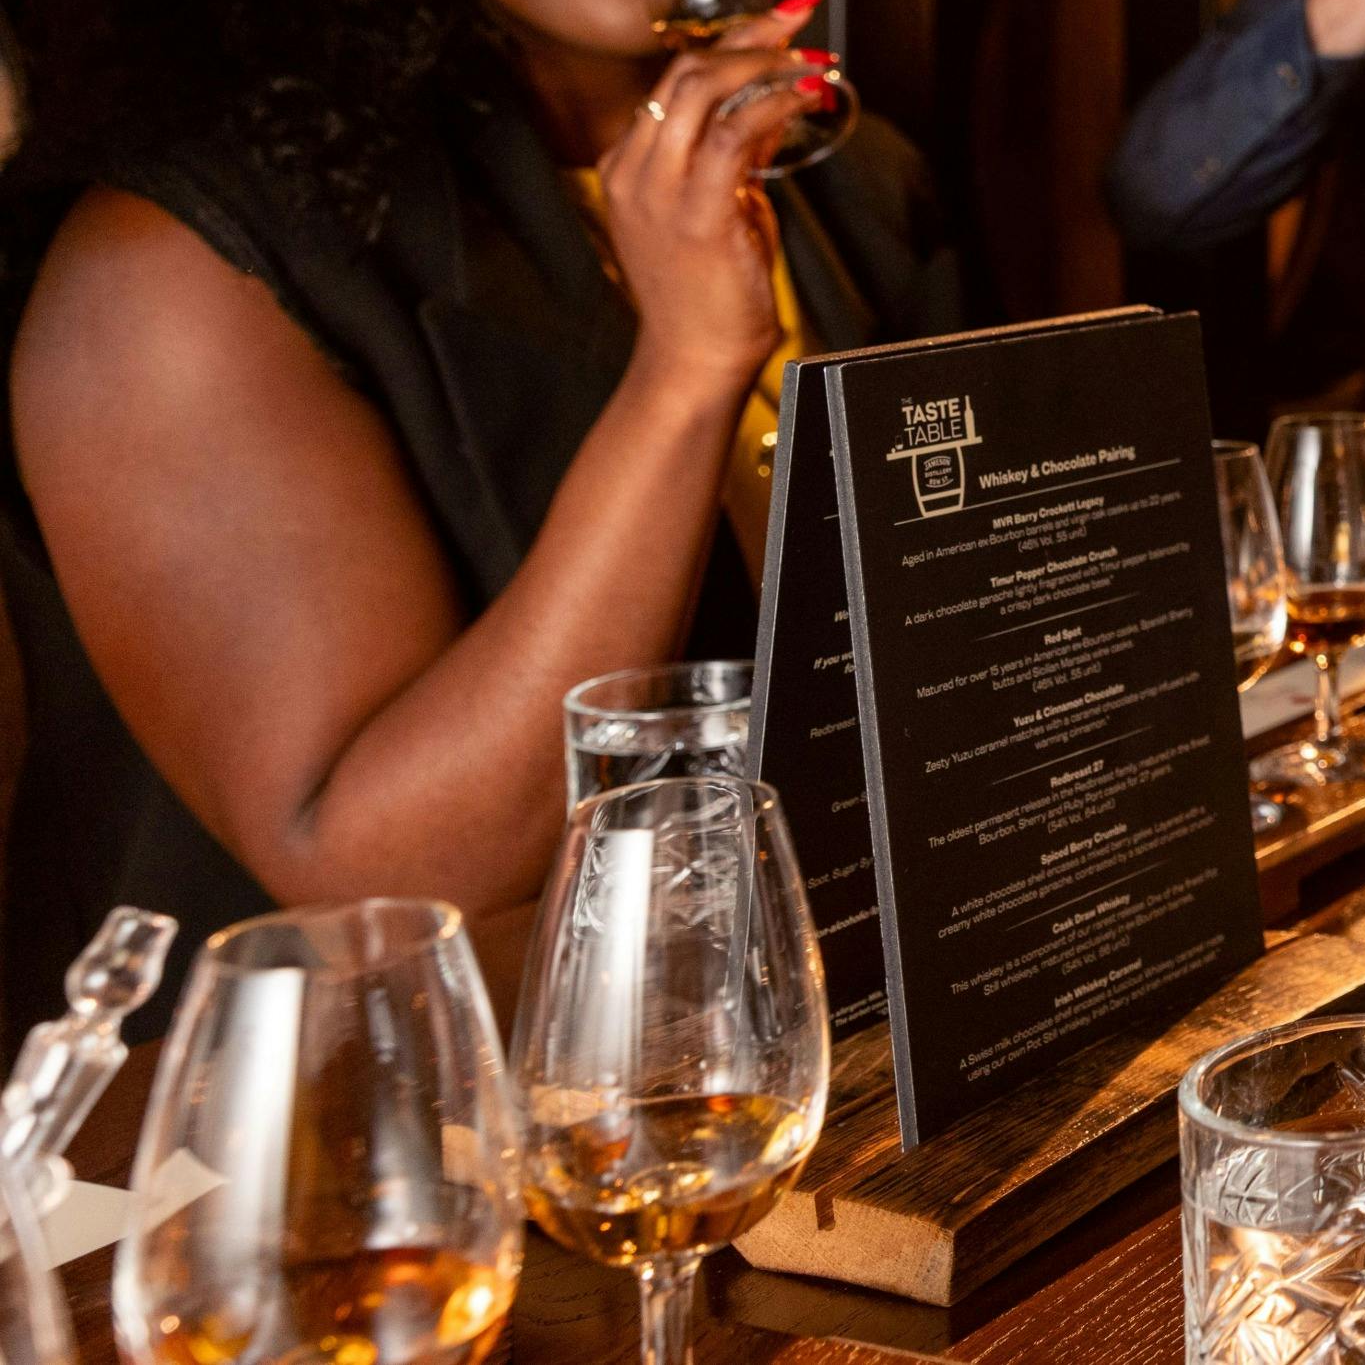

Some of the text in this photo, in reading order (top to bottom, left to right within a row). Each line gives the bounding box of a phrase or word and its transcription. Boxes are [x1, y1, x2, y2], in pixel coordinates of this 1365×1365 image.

[902, 398, 961, 425] TASTE
[904, 418, 963, 446] TABLE
[924, 456, 951, 471] JAMESON
[924, 467, 952, 478] DISTILLERY
[979, 446, 1136, 489] Whiskey & Chocolate Pairing
[993, 497, 1104, 529] MVR Barry Crockett Legacy
[902, 551, 925, 567] Aged
[926, 550, 934, 560] in
[936, 541, 976, 558] American
[977, 530, 1025, 548] ex-Bourbon
[1025, 521, 1054, 536] barrels
[1054, 517, 1070, 529] and
[990, 547, 1118, 588] Timur Pepper Chocolate Crunch
[905, 615, 913, 626] A
[913, 610, 935, 624] dark
[936, 599, 978, 618] chocolate
[979, 589, 1014, 609] ganache
[1015, 583, 1038, 598] lightly
[1038, 569, 1082, 590] fragranced
[1082, 565, 1099, 577] with
[1099, 560, 1121, 572] Timur
[1000, 583, 1091, 615] a crispy dark chocolate
[1044, 626, 1082, 645] Red Spot
[813, 655, 840, 669] If you
[917, 678, 954, 698] Matured
[955, 676, 968, 686] for
[969, 670, 988, 683] over
[989, 664, 999, 676] 15
[1000, 659, 1023, 676] years
[1024, 656, 1032, 665] in
[1033, 645, 1071, 663] American
[992, 647, 1110, 691] butts and Sicilian Marsala wine
[1071, 668, 1082, 680] 55
[1013, 684, 1124, 727] Yuzu & Cinnamon Chocolate
[809, 717, 856, 739] Redbreast
[925, 693, 1139, 773] Zesty Yuzu caramel matches with a caramel chocolate
[1034, 731, 1069, 750] warming
[1050, 759, 1104, 788] Redbreast 27
[832, 797, 859, 813] Green
[928, 771, 1115, 848] The oldest permanent release in the Redbreast
[978, 825, 1018, 845] Bourbon,
[1018, 813, 1046, 830] Sherry
[1047, 804, 1063, 819] and
[1063, 799, 1084, 812] Ruby
[1085, 790, 1103, 803] Port
[1103, 782, 1127, 797] casks
[1040, 823, 1127, 865] Spiced Berry Crumble
[938, 918, 971, 938] creamy
[973, 908, 996, 923] white
[997, 890, 1038, 913] chocolate
[1075, 854, 1118, 880] contrasted
[1117, 853, 1127, 863] by
[952, 906, 959, 917] A
[960, 897, 984, 913] white
[985, 880, 1026, 903] chocolate
[1027, 870, 1046, 886] shell
[1046, 858, 1079, 877] encases
[1087, 843, 1110, 860] mixed
[1052, 894, 1130, 934] Cask Draw Whiskey
[950, 980, 969, 994] This
[970, 965, 1004, 986] whiskey
[1006, 961, 1013, 970] is
[1021, 936, 1067, 963] component
[1067, 929, 1076, 943] of
[1077, 925, 1091, 938] our
[1094, 914, 1116, 930] rarest
[984, 980, 999, 995] Still
[1041, 946, 1075, 968] matured
[1076, 929, 1116, 954] exclusively
[1055, 958, 1142, 1008] Irish Whiskey Caramel
[960, 1059, 968, 1070] A
[968, 1047, 994, 1065] Swiss
[994, 1038, 1012, 1052] milk
[1013, 1018, 1054, 1044] chocolate
[1054, 1006, 1072, 1023] shell
[1073, 992, 1106, 1014] encases
[1143, 959, 1175, 978] Whiskey
[967, 1064, 991, 1082] using
[991, 1056, 1006, 1069] our
[1008, 1047, 1025, 1061] own
[1026, 1038, 1042, 1051] Pot
[1042, 1029, 1058, 1044] Still
[1092, 1005, 1109, 1019] Irish
[1109, 995, 1130, 1010] Dairy
[1131, 985, 1146, 1000] and
